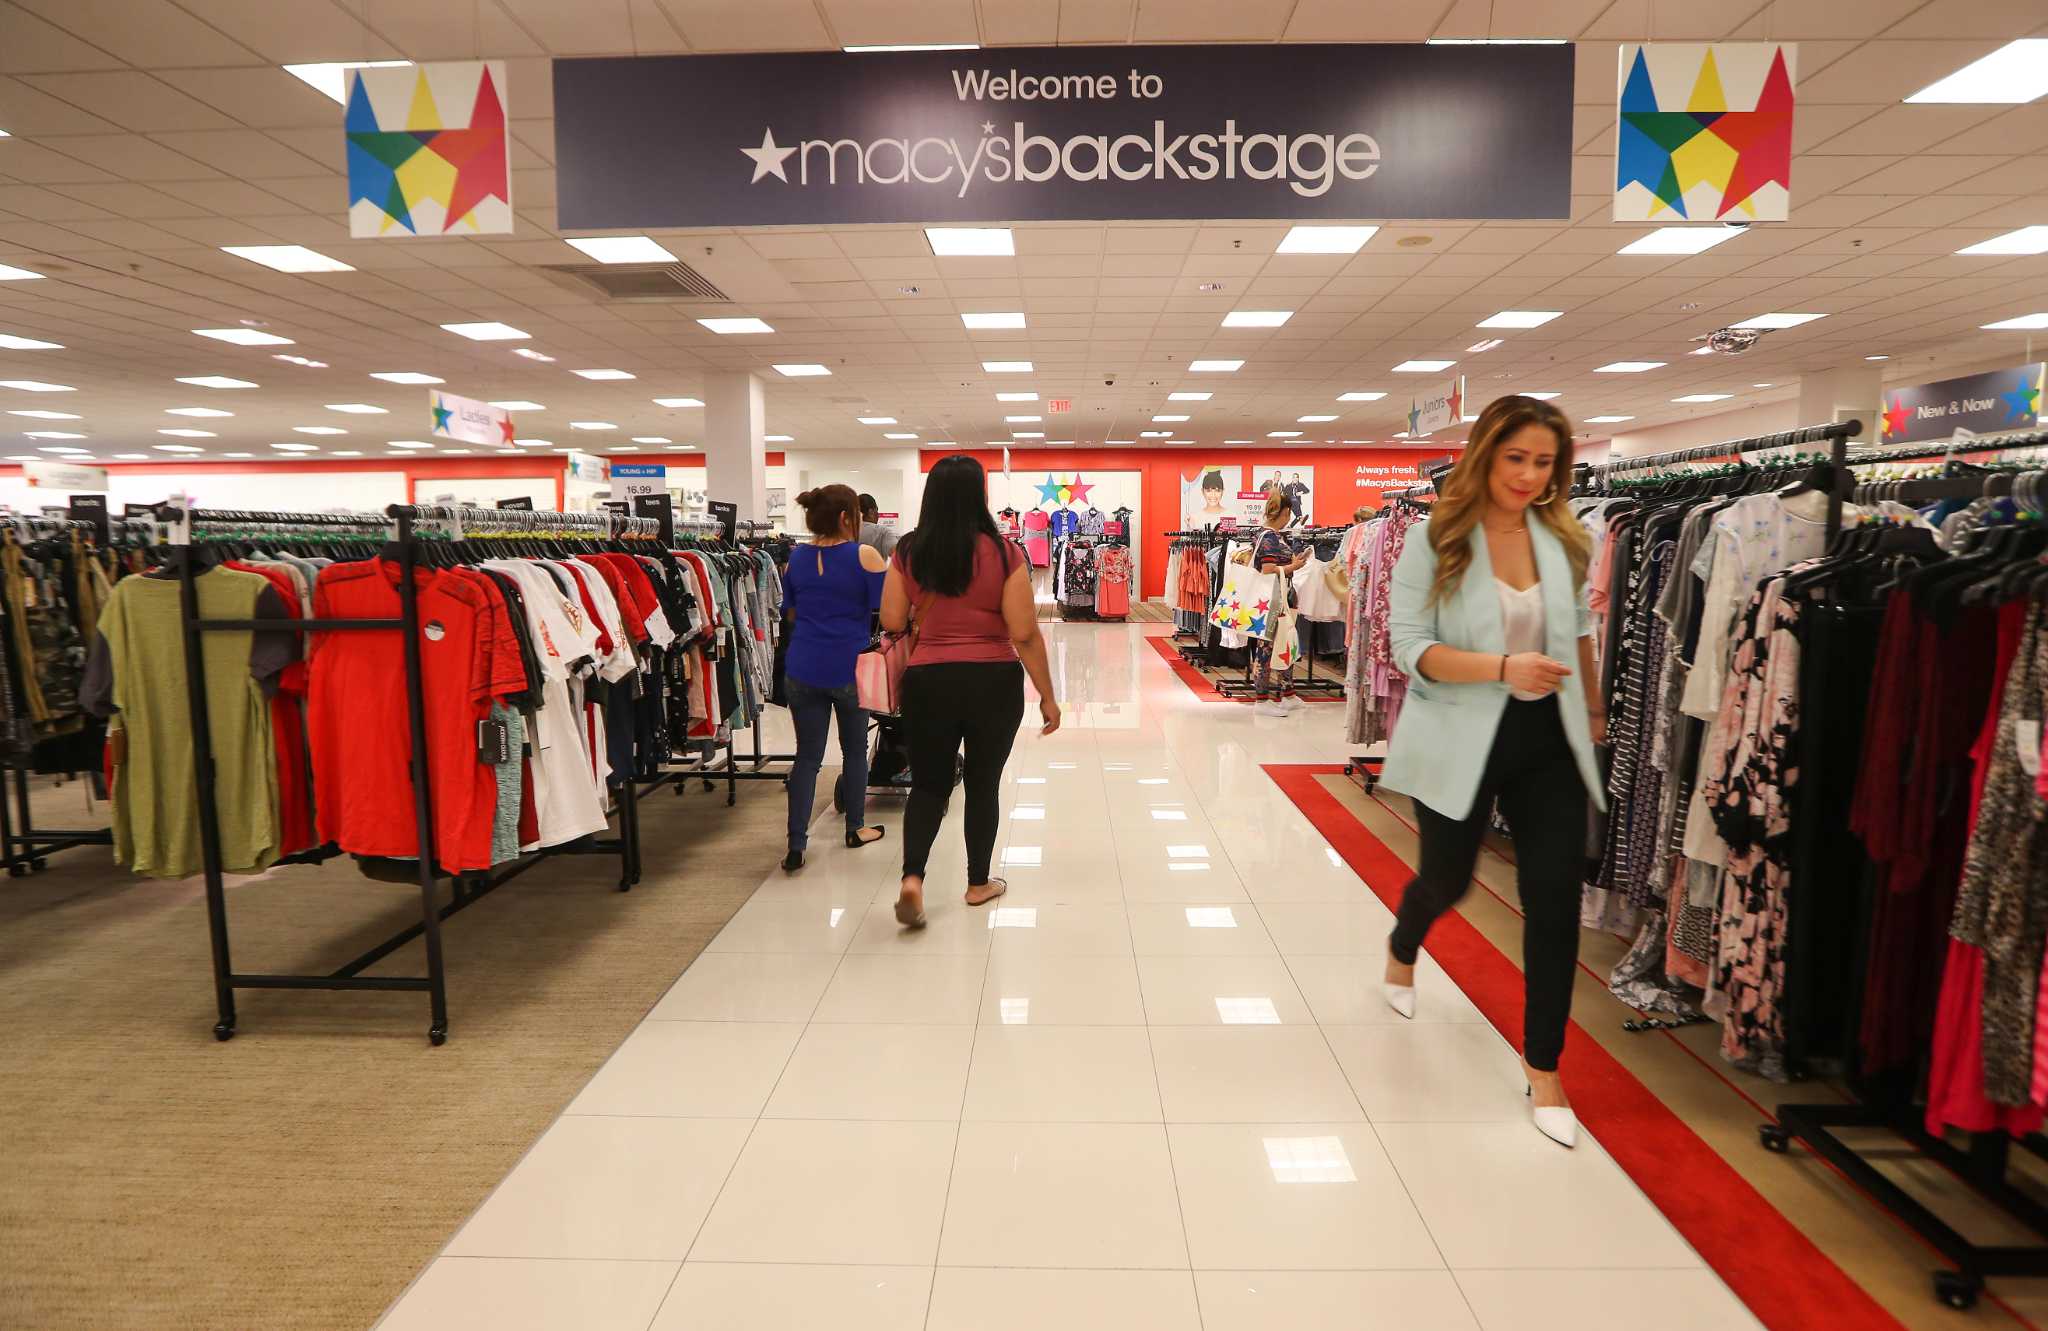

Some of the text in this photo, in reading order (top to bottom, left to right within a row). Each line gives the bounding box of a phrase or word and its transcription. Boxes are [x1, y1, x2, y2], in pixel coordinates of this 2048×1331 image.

[952, 69, 1163, 100] Welcome to
[1049, 401, 1071, 412] EXIT
[1918, 399, 1995, 419] New & Now
[1356, 466, 1389, 475] Always
[1391, 465, 1418, 474] fresh.
[1356, 478, 1434, 488] #MacysBackstag
[627, 485, 652, 494] 16.99
[504, 502, 525, 510] woven
